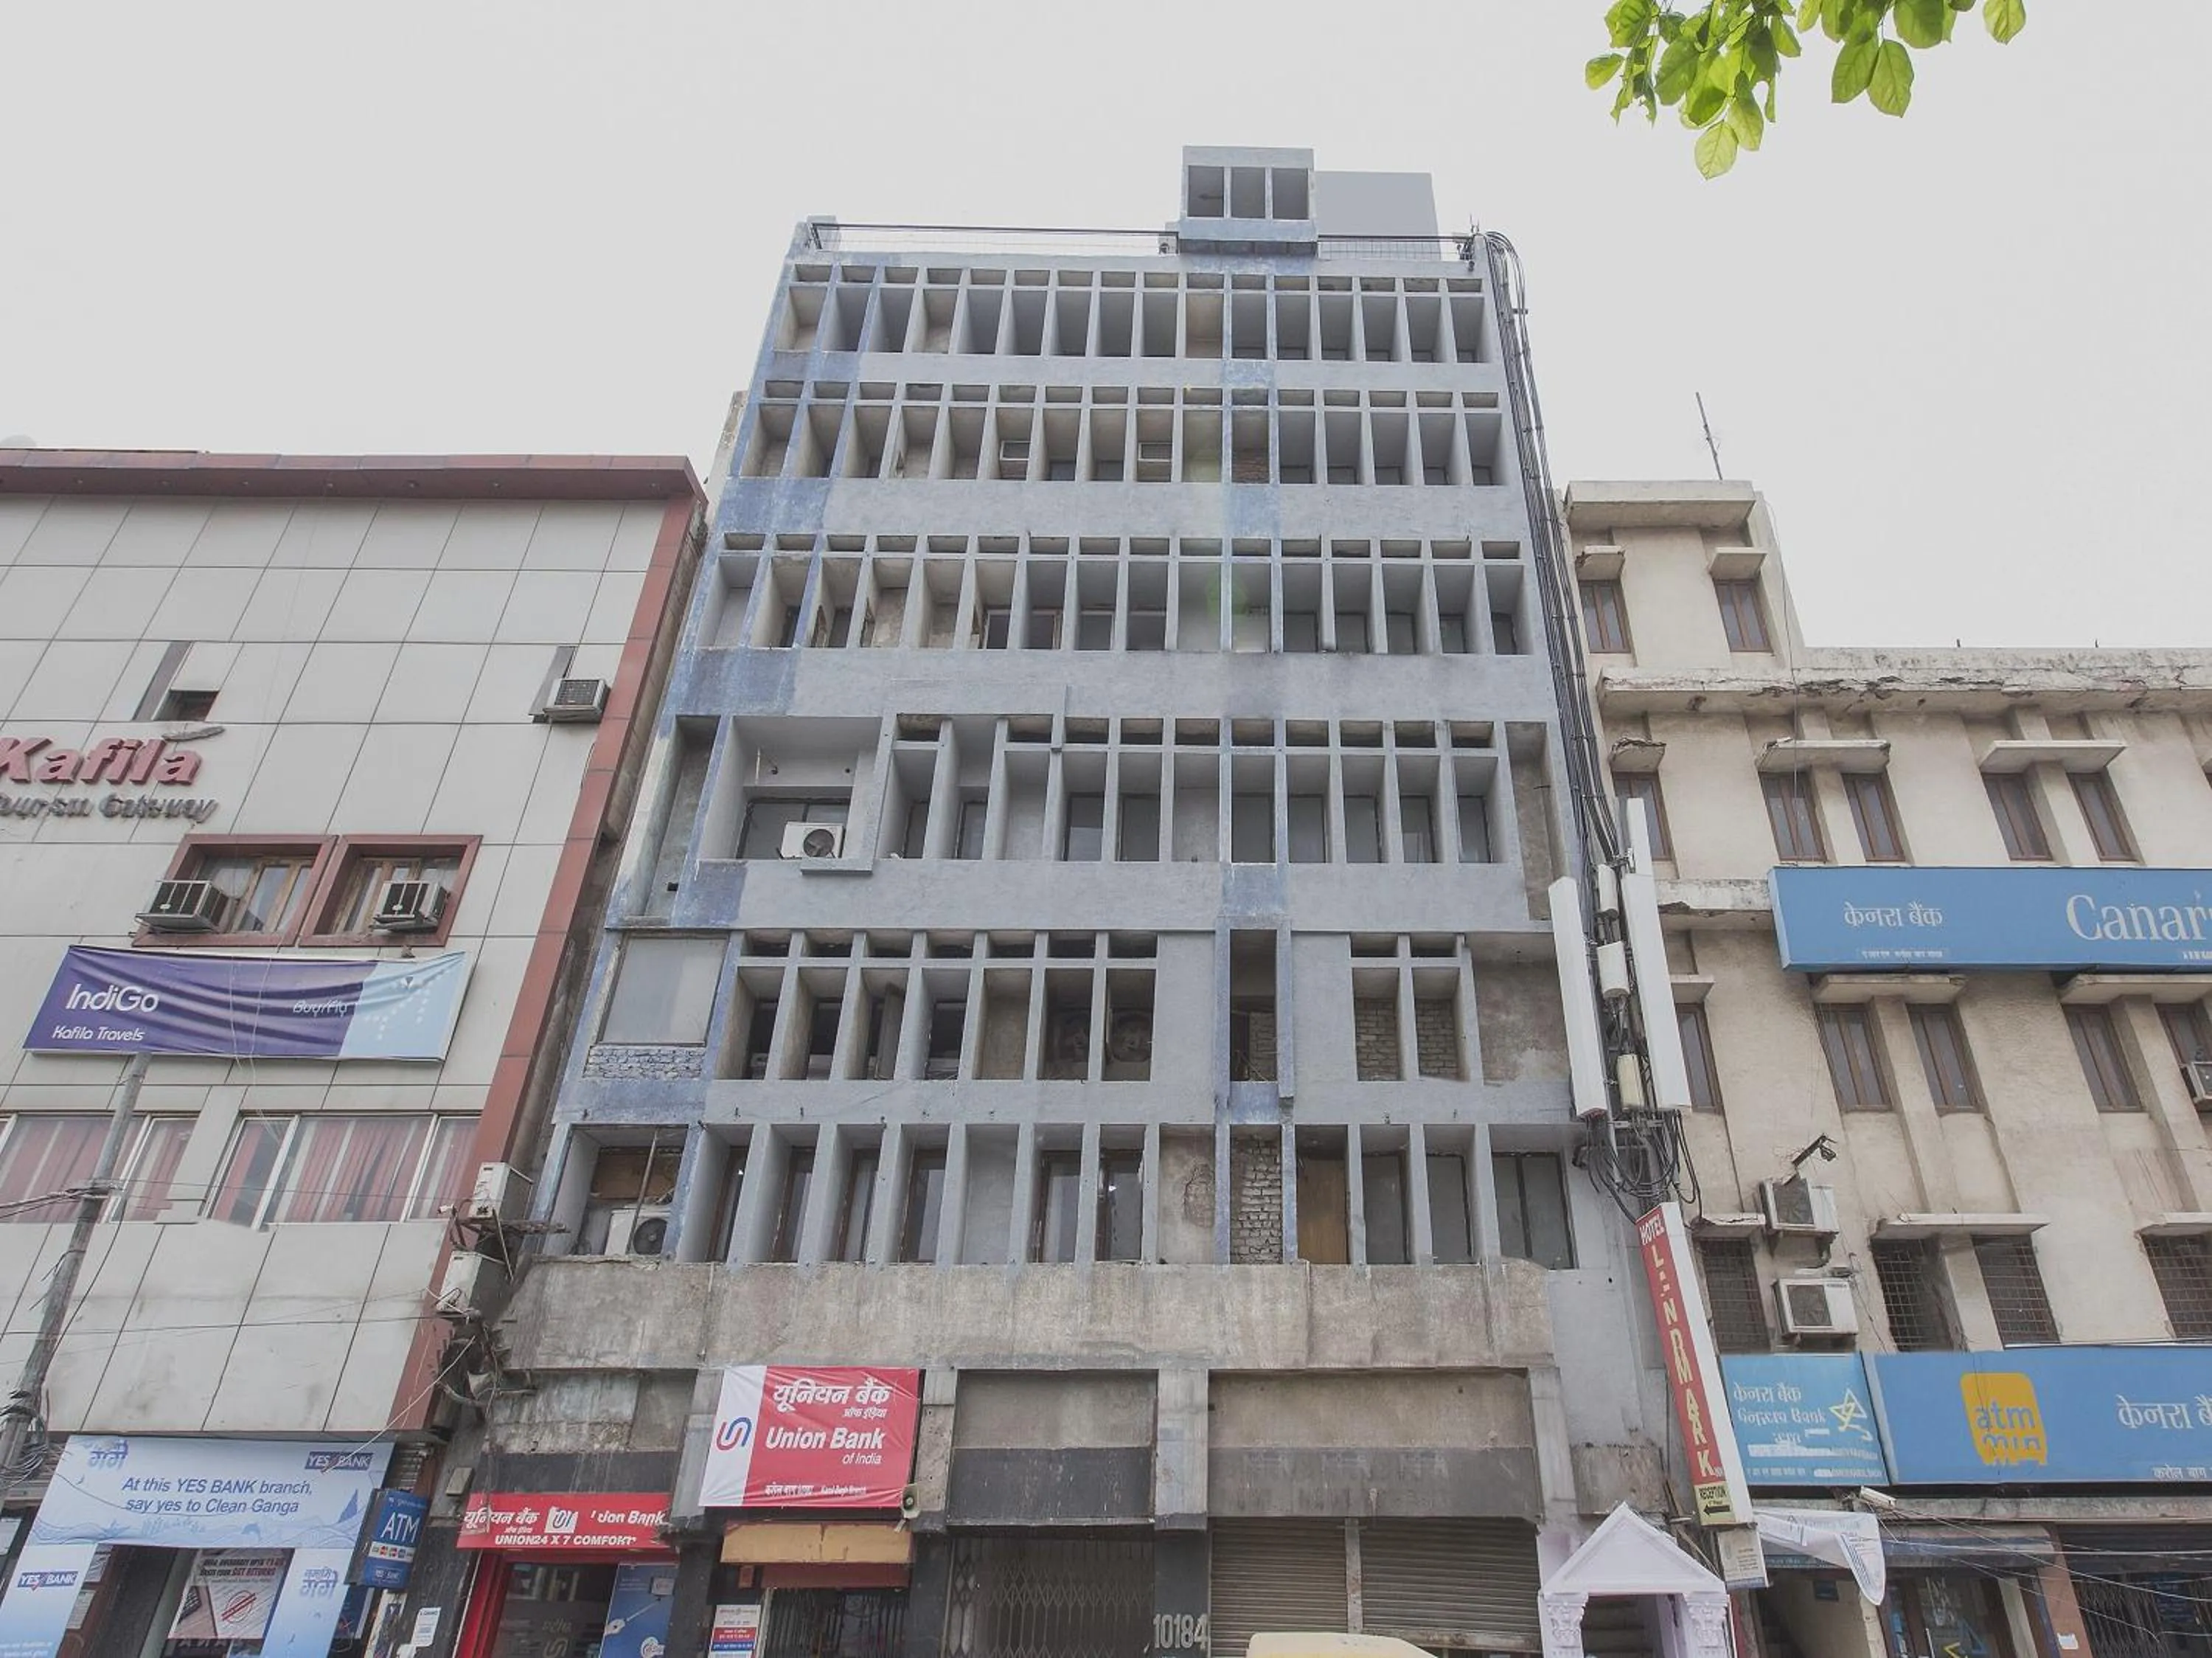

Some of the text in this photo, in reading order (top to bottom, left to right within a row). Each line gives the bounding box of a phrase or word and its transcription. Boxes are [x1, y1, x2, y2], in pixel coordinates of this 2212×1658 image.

[0, 737, 201, 785] Kafila
[99, 793, 219, 824] Gateway
[1844, 900, 1943, 927] केनरा बैंक
[2066, 894, 2212, 941] Canar
[65, 983, 160, 1013] IndiGo
[52, 1025, 146, 1041] Kafila Travels
[1639, 1214, 1665, 1246] HOTEL
[773, 1376, 893, 1412] यूनियन बैंक
[1975, 1400, 2036, 1429] atm
[2116, 1394, 2194, 1429] केनरा
[765, 1427, 886, 1449] Union Bank
[308, 1455, 370, 1468] YES BANK
[841, 1453, 882, 1464] of India
[122, 1477, 313, 1496] At this YES BANK branch,
[126, 1499, 299, 1515] say yes to Clean Ganga
[627, 1510, 666, 1526] Bank
[380, 1512, 420, 1543] ATM
[550, 1535, 560, 1545] X
[563, 1535, 568, 1545] 7
[21, 1573, 78, 1585] YES BANK
[1152, 1614, 1208, 1650] 10184
